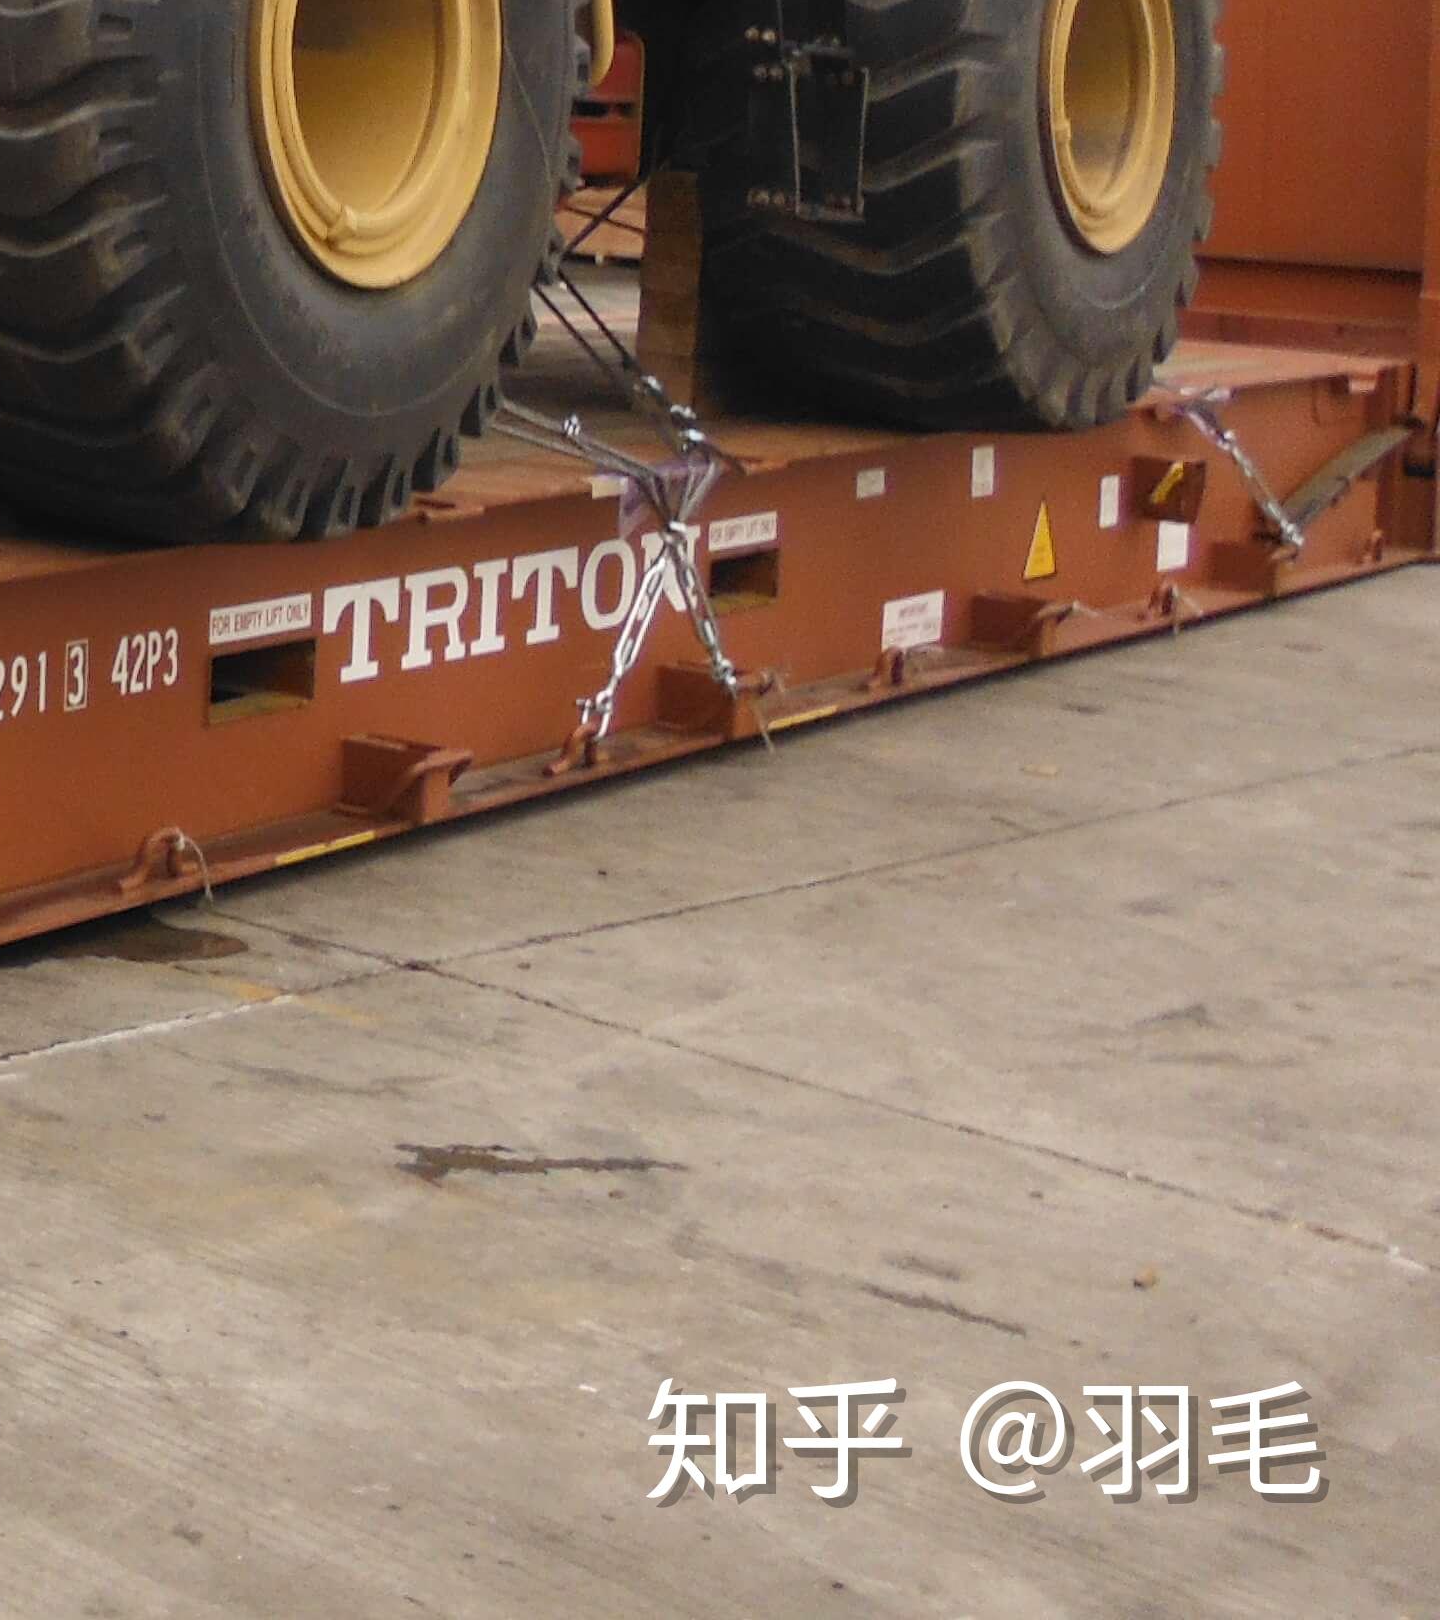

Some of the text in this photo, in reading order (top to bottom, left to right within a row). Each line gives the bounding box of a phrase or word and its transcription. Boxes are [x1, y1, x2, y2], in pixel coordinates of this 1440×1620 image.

[212, 601, 309, 637] FOR EMPTY LIFT ONLY
[323, 526, 701, 684] TRITON
[67, 645, 84, 705] 3
[111, 628, 179, 696] 42P3
